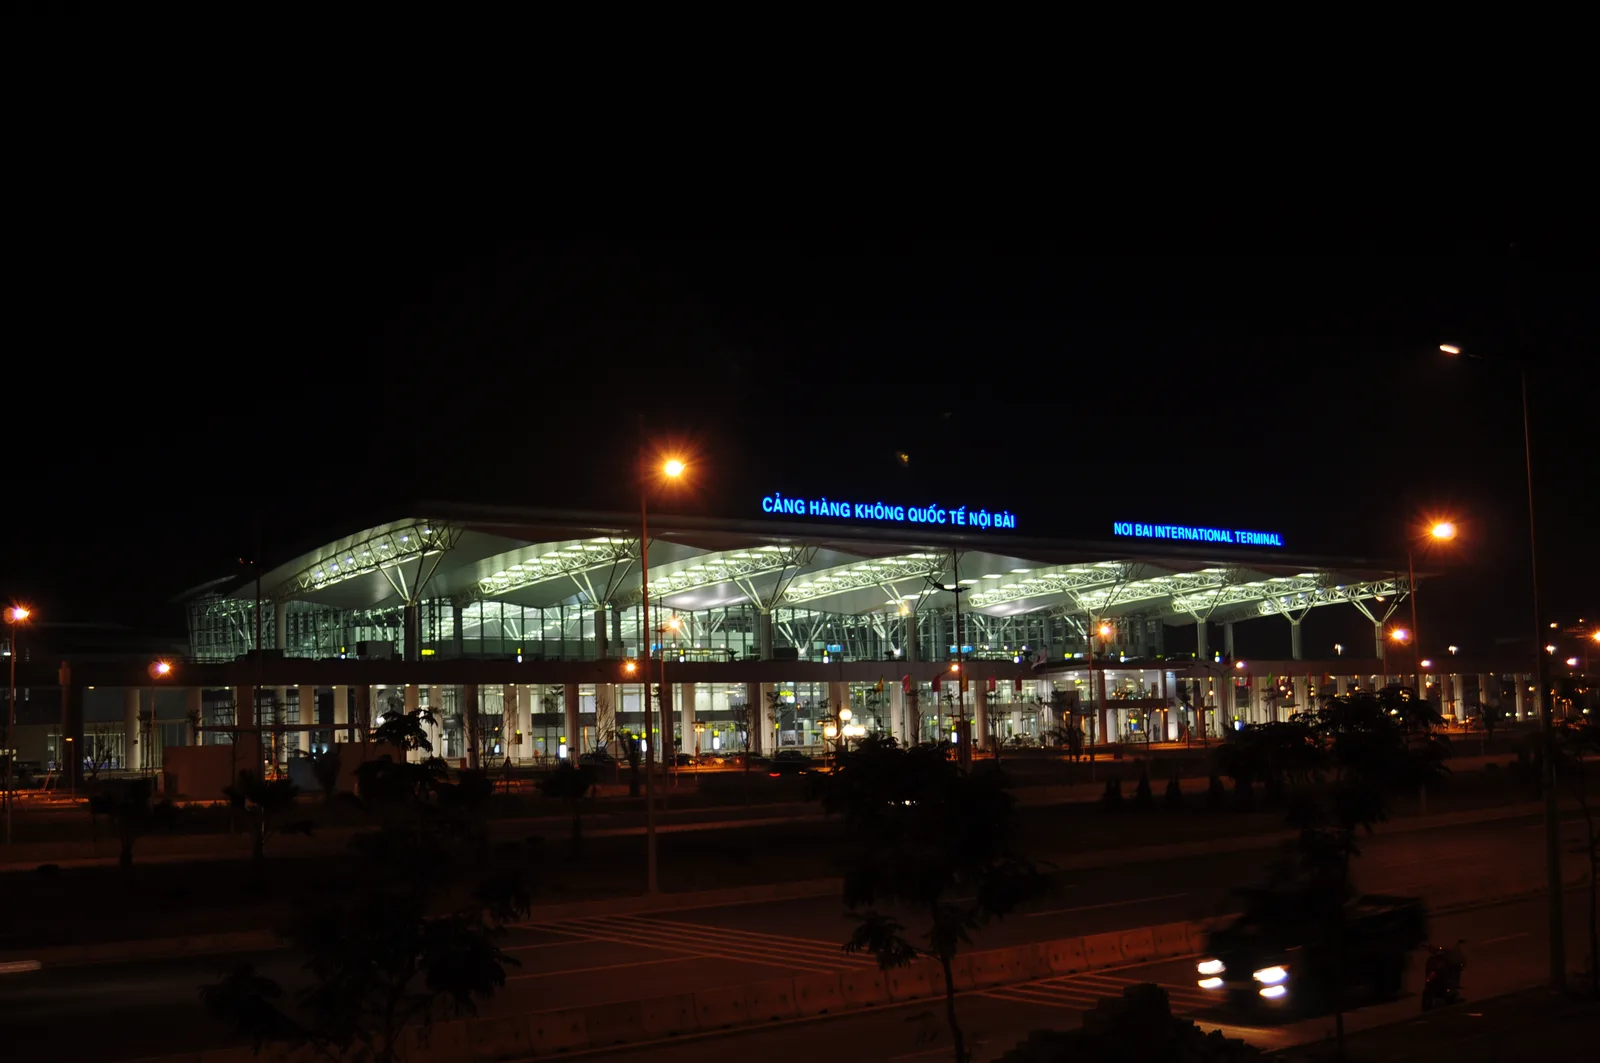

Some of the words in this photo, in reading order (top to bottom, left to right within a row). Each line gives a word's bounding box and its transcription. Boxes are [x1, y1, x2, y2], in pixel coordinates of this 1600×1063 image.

[762, 492, 806, 514] CẢNG
[809, 497, 851, 518] HÀNG
[854, 502, 905, 522] KHÔNG
[908, 504, 946, 524] QUỐC
[949, 505, 966, 526] TẾ
[969, 509, 991, 529] NỘI
[994, 511, 1015, 528] BÀI
[1113, 522, 1133, 536] NOI
[1135, 524, 1153, 538] BAI
[1154, 525, 1233, 543] INTERNATIONAL
[1234, 531, 1282, 546] TERMINAL
